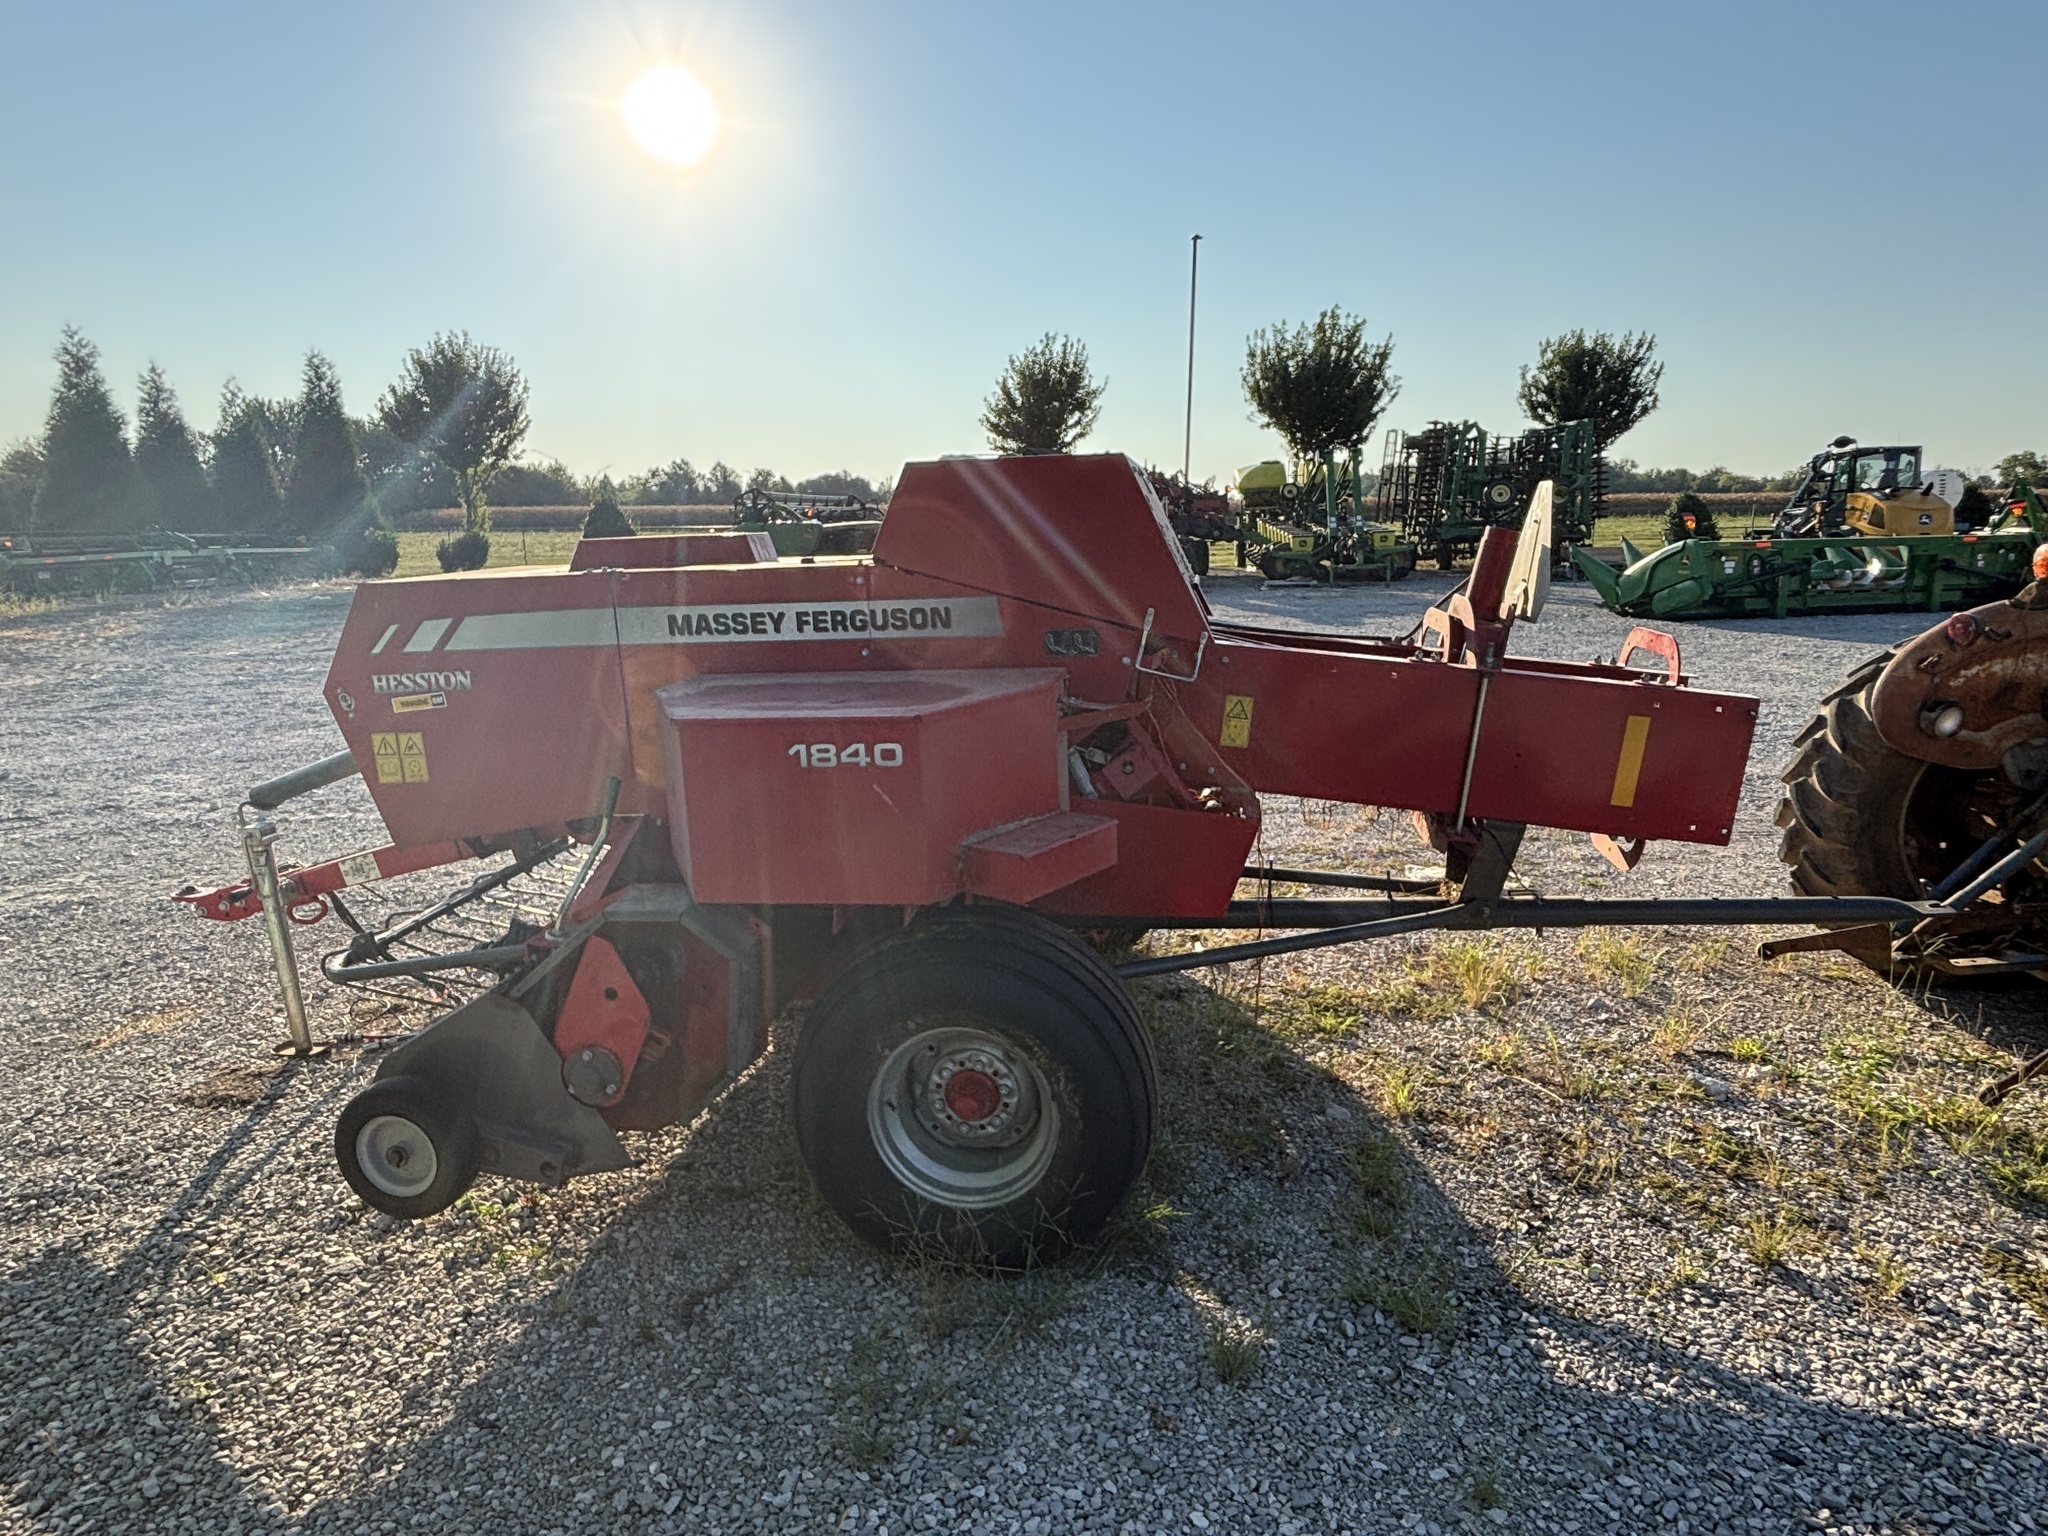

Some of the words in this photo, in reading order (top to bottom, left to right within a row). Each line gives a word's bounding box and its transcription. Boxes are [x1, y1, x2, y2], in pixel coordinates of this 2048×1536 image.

[666, 610, 786, 636] MASSEY
[796, 607, 953, 634] FERGUSON
[371, 670, 471, 694] HESSTON
[788, 743, 904, 768] 1840
